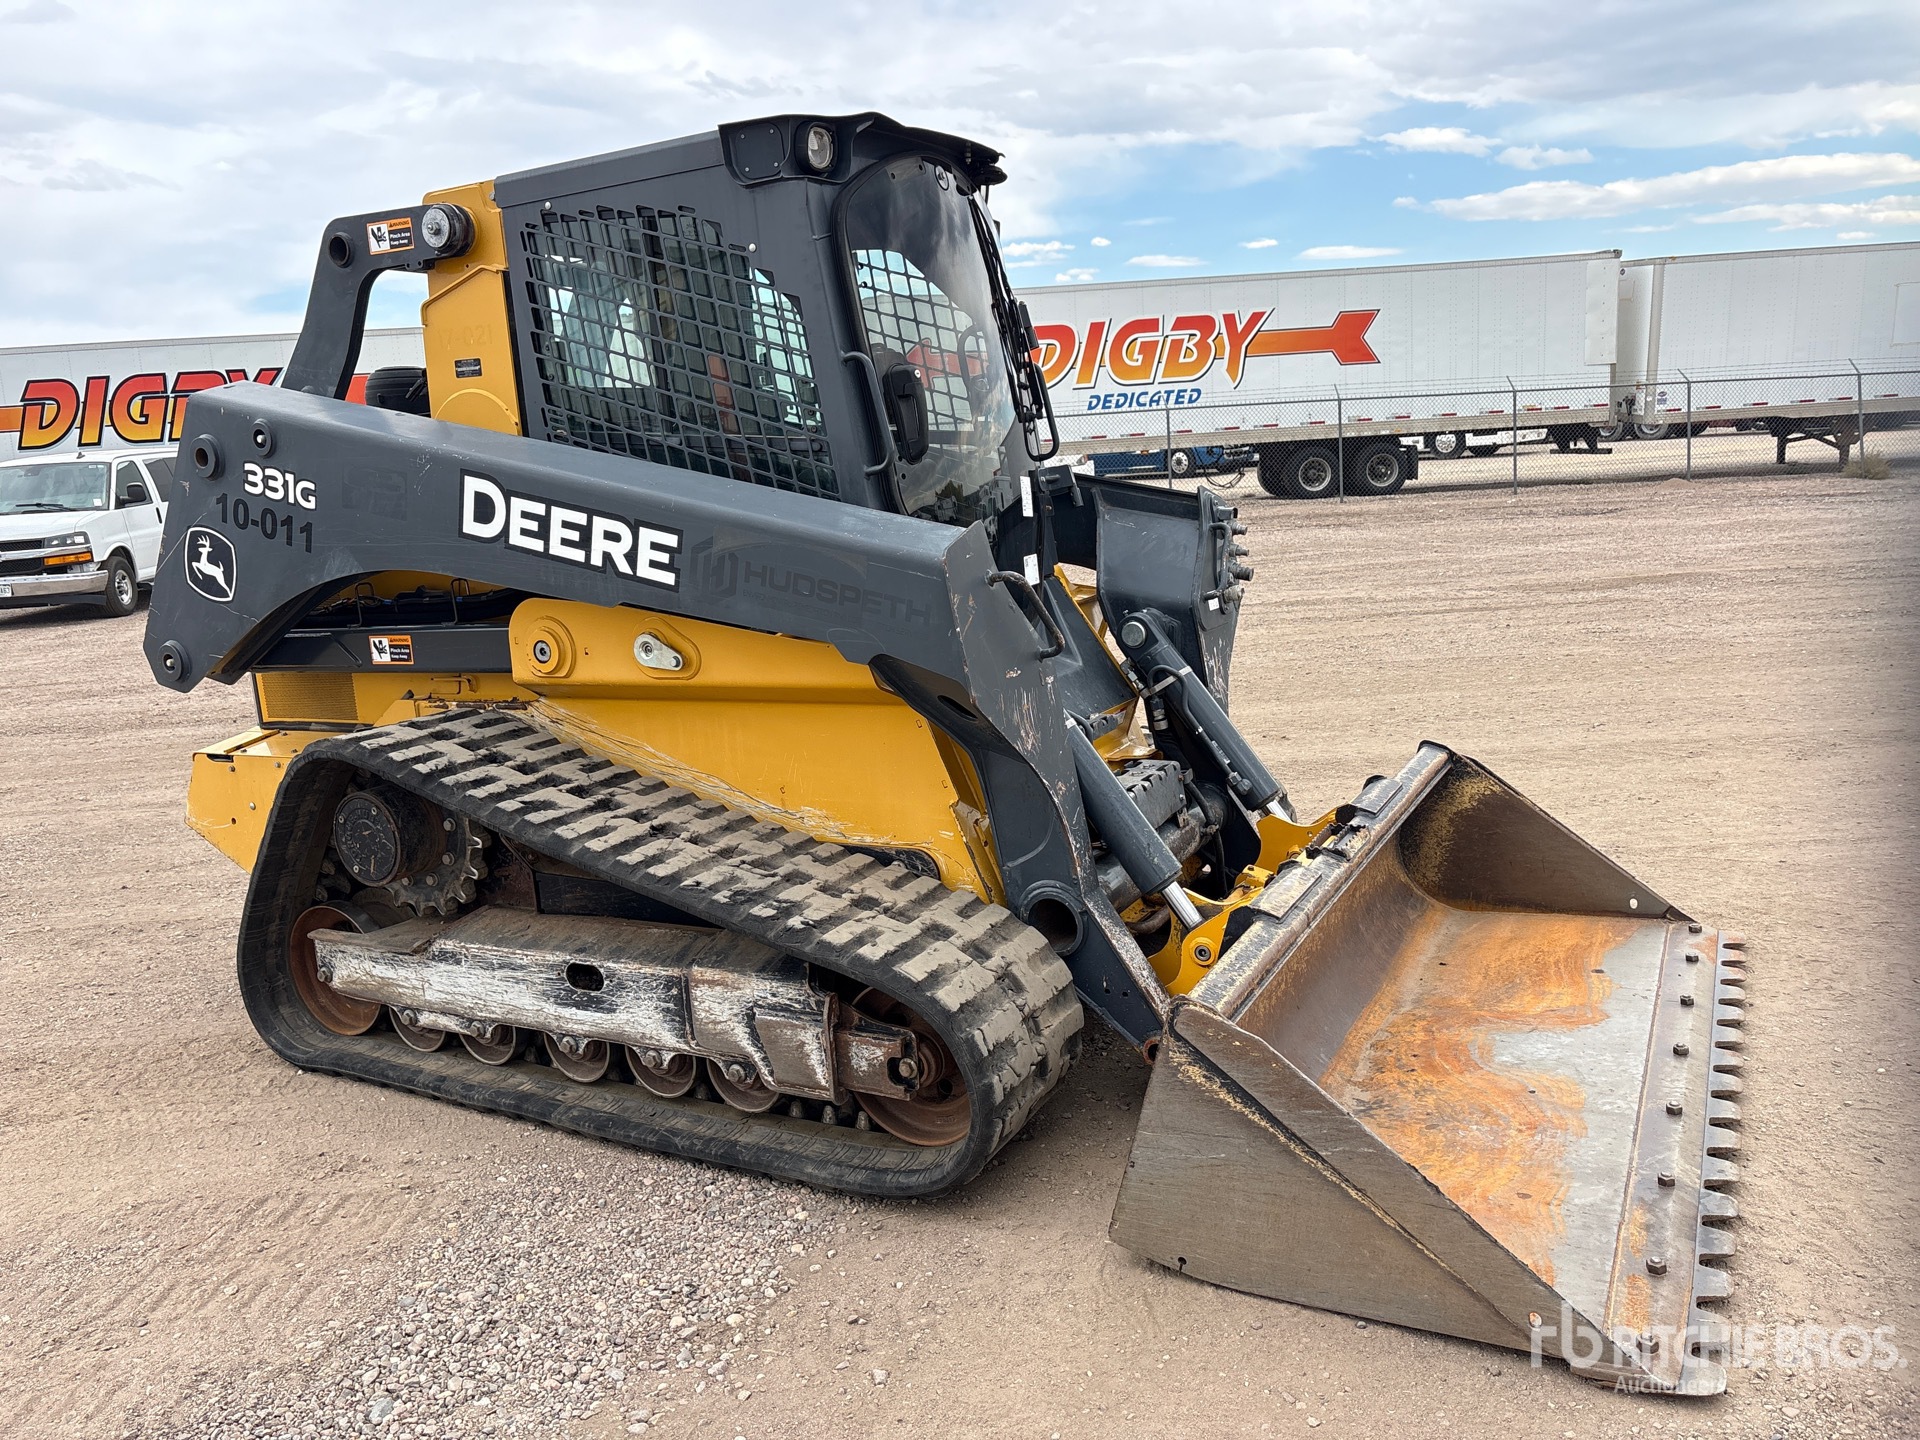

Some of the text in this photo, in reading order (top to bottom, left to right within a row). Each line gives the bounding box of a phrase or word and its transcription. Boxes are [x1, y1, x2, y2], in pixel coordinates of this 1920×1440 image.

[1029, 307, 1275, 390] DIGBY
[17, 367, 286, 450] DIG
[1086, 388, 1202, 411] DEDICATED
[243, 462, 317, 510] 331G
[216, 492, 313, 554] 10-011
[461, 473, 679, 587] DEERE
[744, 561, 933, 624] HUDSPETH
